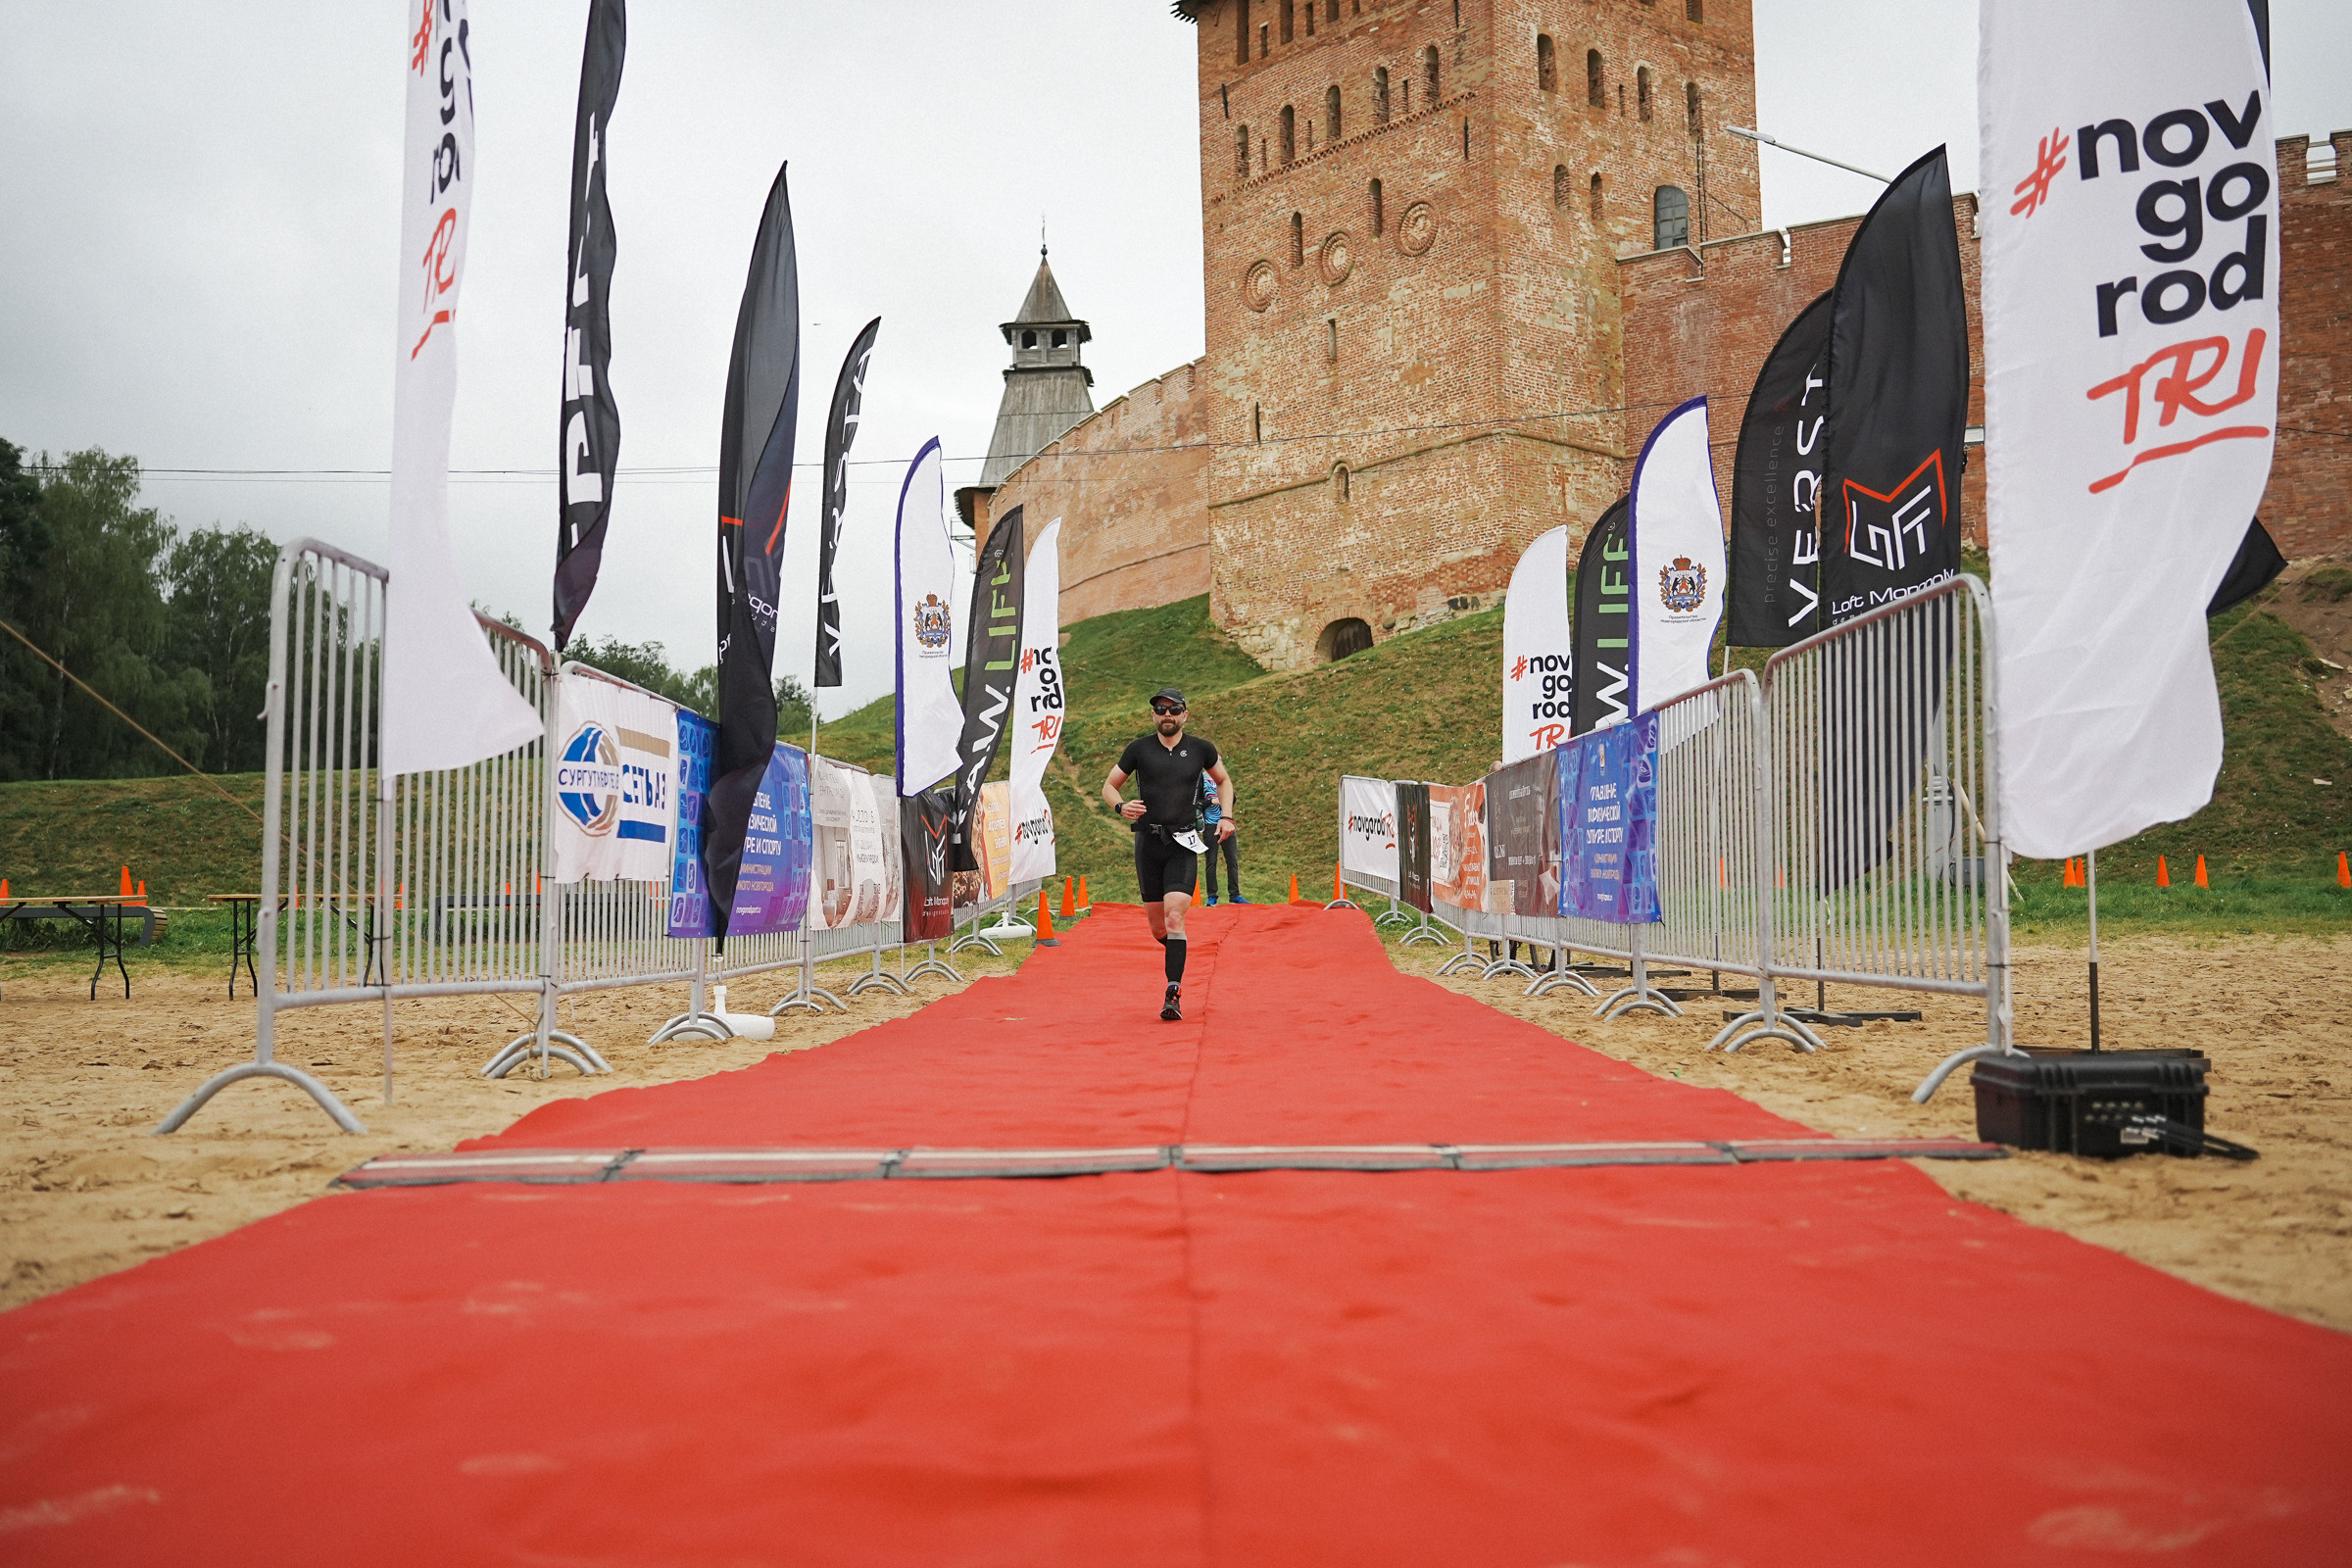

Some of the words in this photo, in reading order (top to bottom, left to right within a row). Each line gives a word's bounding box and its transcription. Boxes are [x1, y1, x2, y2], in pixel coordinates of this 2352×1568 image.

[2010, 89, 2263, 220] #nov
[2135, 162, 2271, 264] go
[2095, 214, 2268, 339] rod
[2086, 327, 2268, 446] TRI
[1763, 425, 1785, 527] excellence
[1764, 535, 1780, 604] precise
[1832, 595, 1864, 615] Loft
